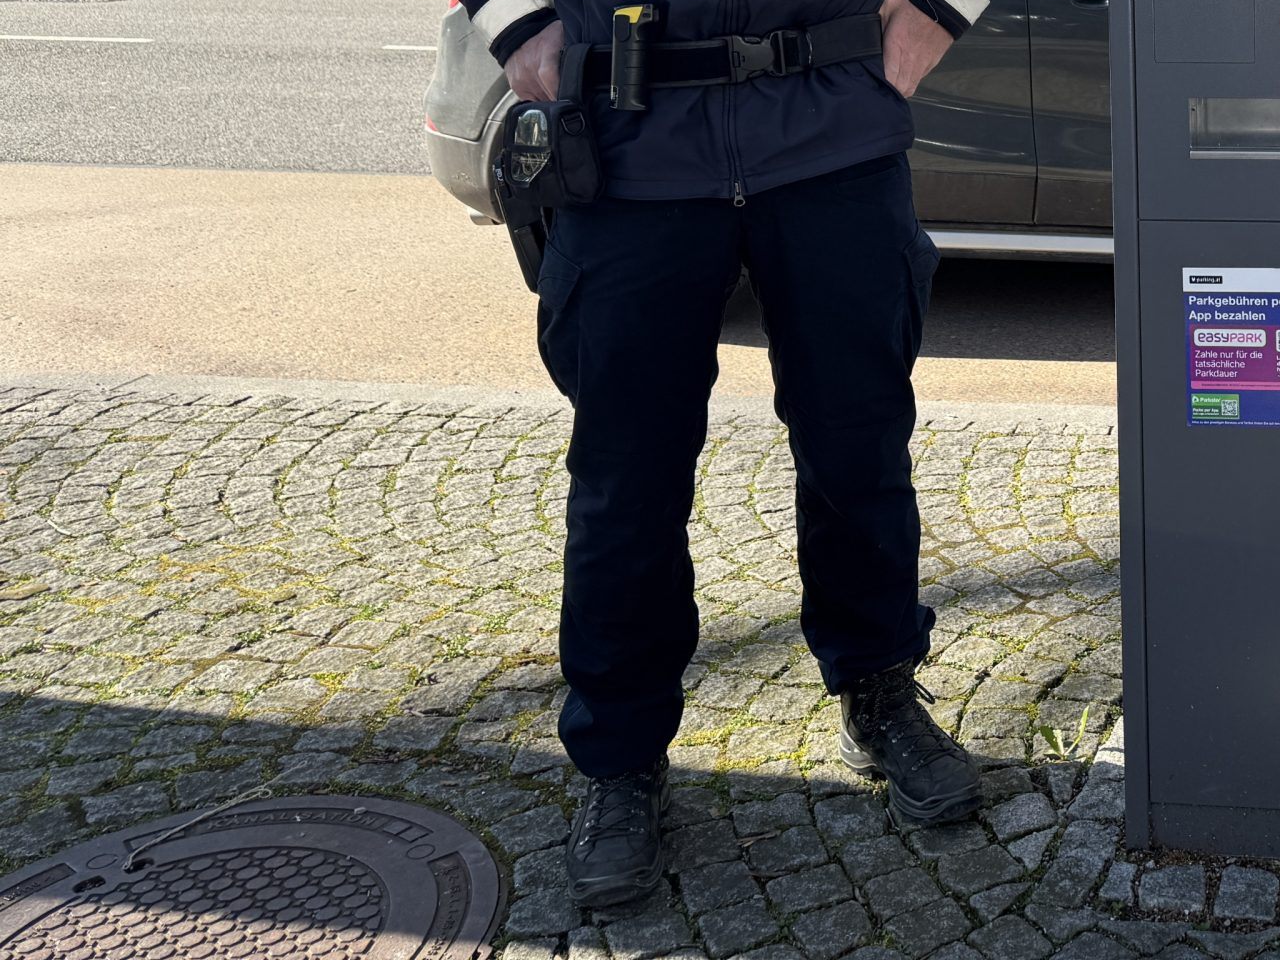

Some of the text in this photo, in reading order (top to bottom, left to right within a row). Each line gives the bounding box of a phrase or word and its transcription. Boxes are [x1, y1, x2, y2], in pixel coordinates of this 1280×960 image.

[1188, 295, 1268, 307] Parkgebühren
[1188, 310, 1266, 322] App bezahlen
[1195, 350, 1218, 359] Zahle
[1236, 350, 1248, 359] für
[1250, 350, 1263, 359] die
[1195, 360, 1246, 368] tatsächliche
[1195, 369, 1238, 378] Parkdauer
